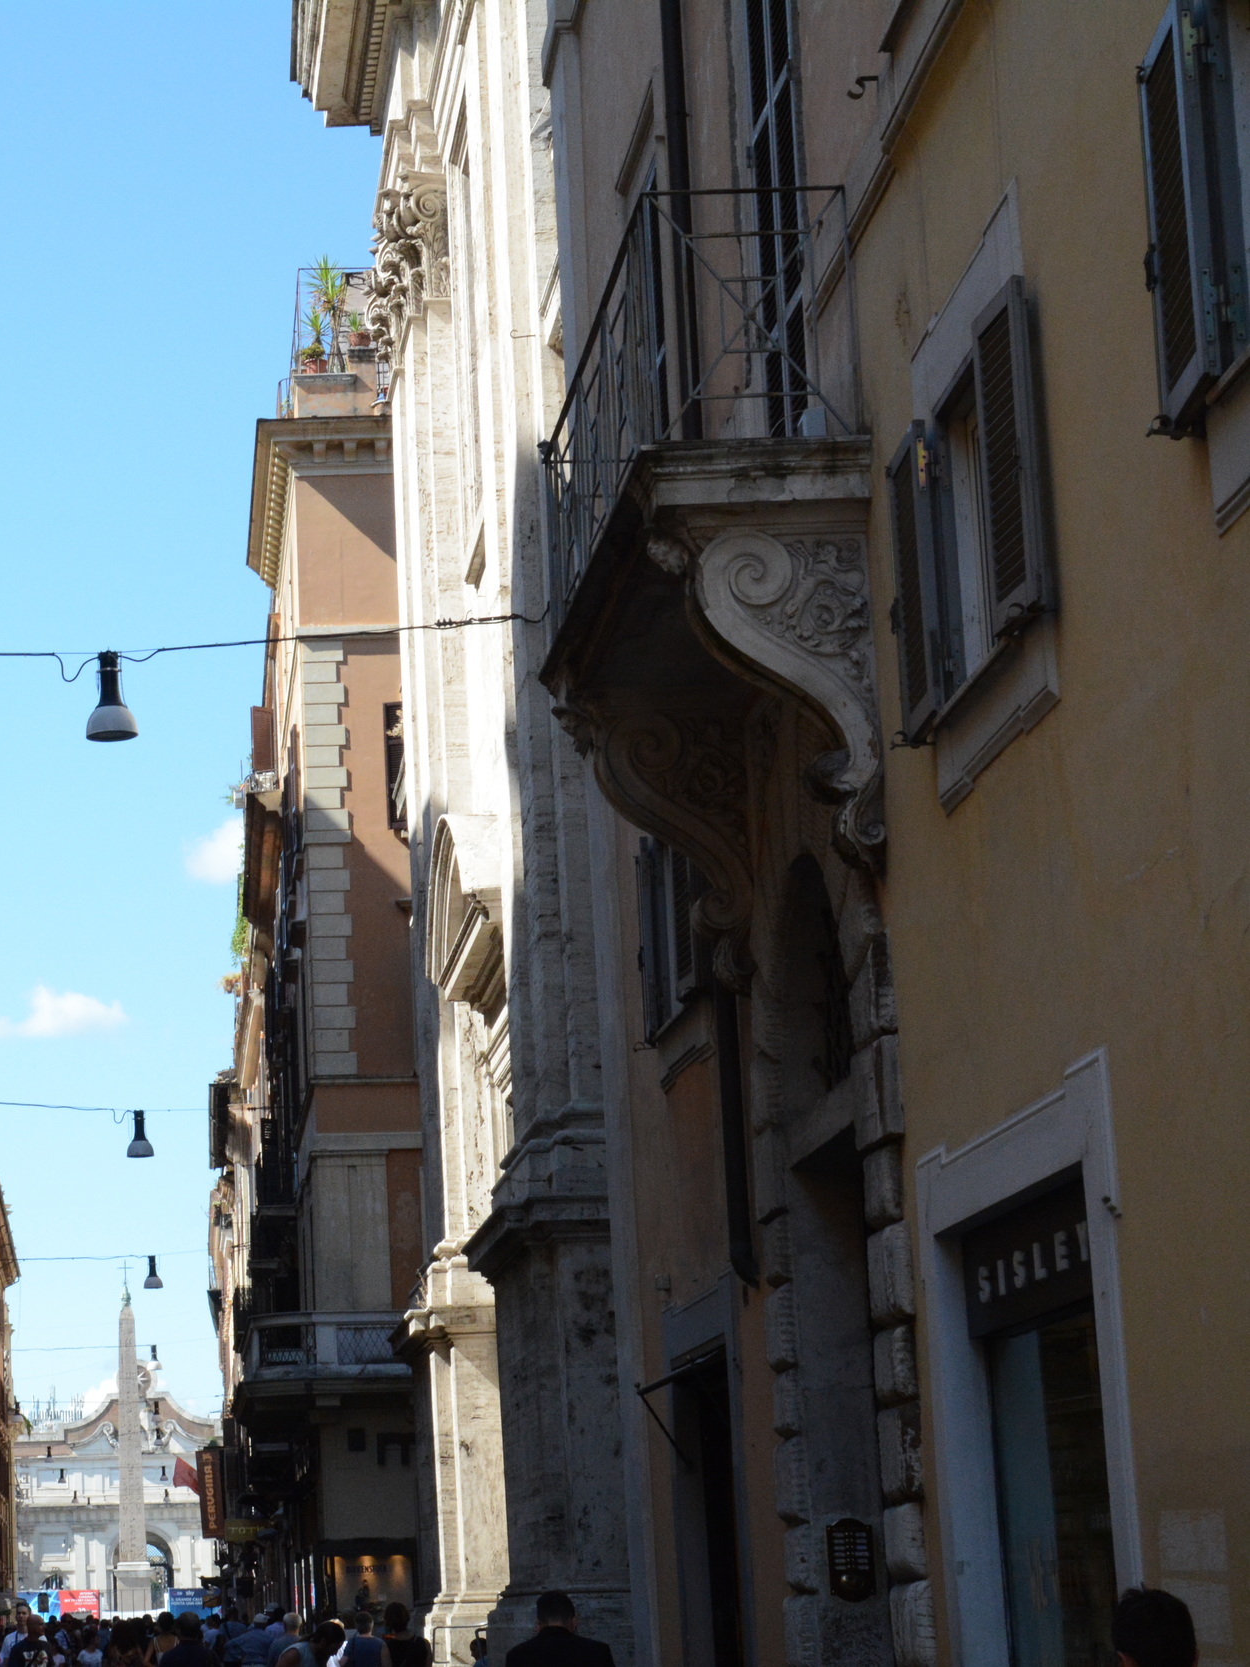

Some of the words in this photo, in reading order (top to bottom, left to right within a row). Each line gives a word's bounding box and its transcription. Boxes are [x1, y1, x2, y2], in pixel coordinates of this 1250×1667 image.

[977, 1221, 1089, 1304] SISLEY
[203, 1465, 218, 1530] PERUGINA
[346, 1565, 388, 1574] BIRKENSTOCK
